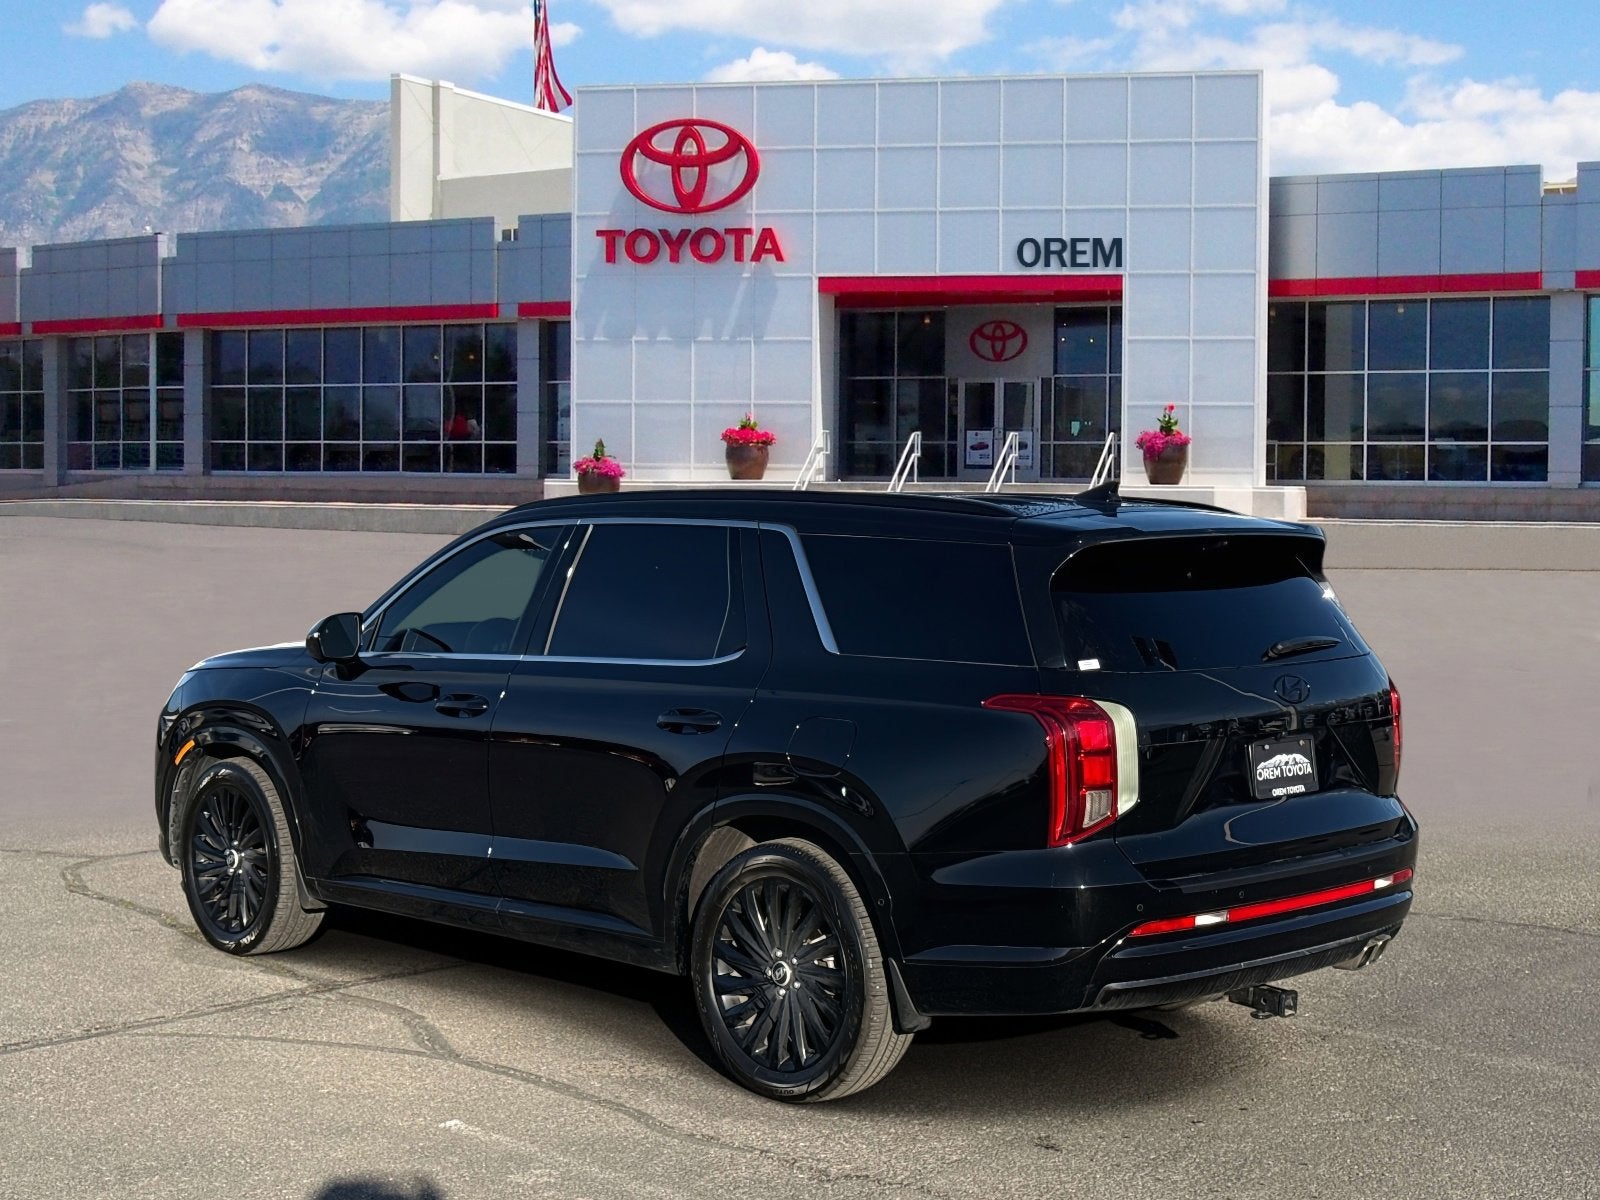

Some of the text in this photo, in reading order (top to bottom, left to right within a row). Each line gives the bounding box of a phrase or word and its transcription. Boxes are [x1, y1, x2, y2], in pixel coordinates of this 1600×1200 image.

[596, 227, 785, 264] TOYOTA
[1017, 237, 1123, 267] OREM
[1257, 763, 1312, 780] OREM TOYOTA
[1272, 785, 1305, 796] OREM TOYOTA
